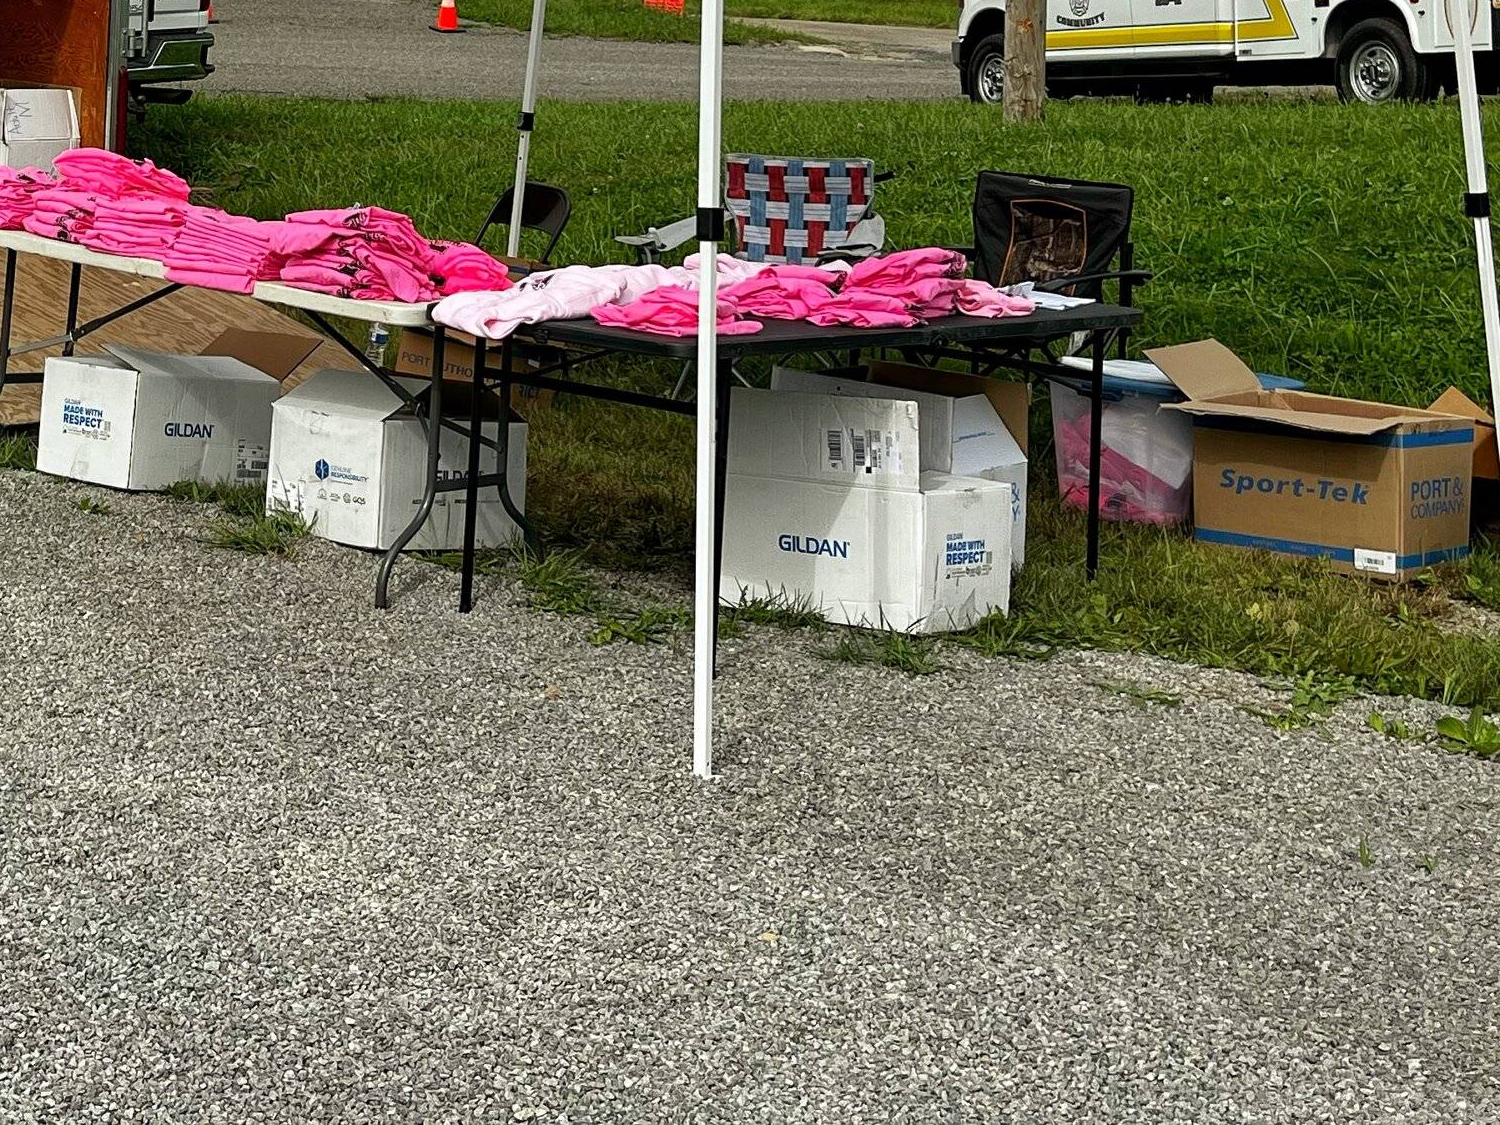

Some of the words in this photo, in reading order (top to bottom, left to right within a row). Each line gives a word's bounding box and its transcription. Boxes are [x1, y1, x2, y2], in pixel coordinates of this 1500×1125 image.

[1056, 12, 1105, 27] COMMUNITY
[402, 352, 431, 367] PORT
[64, 405, 84, 415] MADE
[85, 407, 103, 418] WITH
[63, 413, 102, 429] RESPECT
[164, 422, 213, 438] GILDAN
[1220, 468, 1369, 505] Sport-Tek
[1411, 477, 1451, 501] PORT
[1452, 476, 1463, 496] &
[1411, 497, 1462, 520] COMPANY
[778, 534, 848, 558] GILDAN
[946, 541, 966, 552] MADE
[967, 539, 985, 550] WITH
[946, 550, 986, 565] RESPECT
